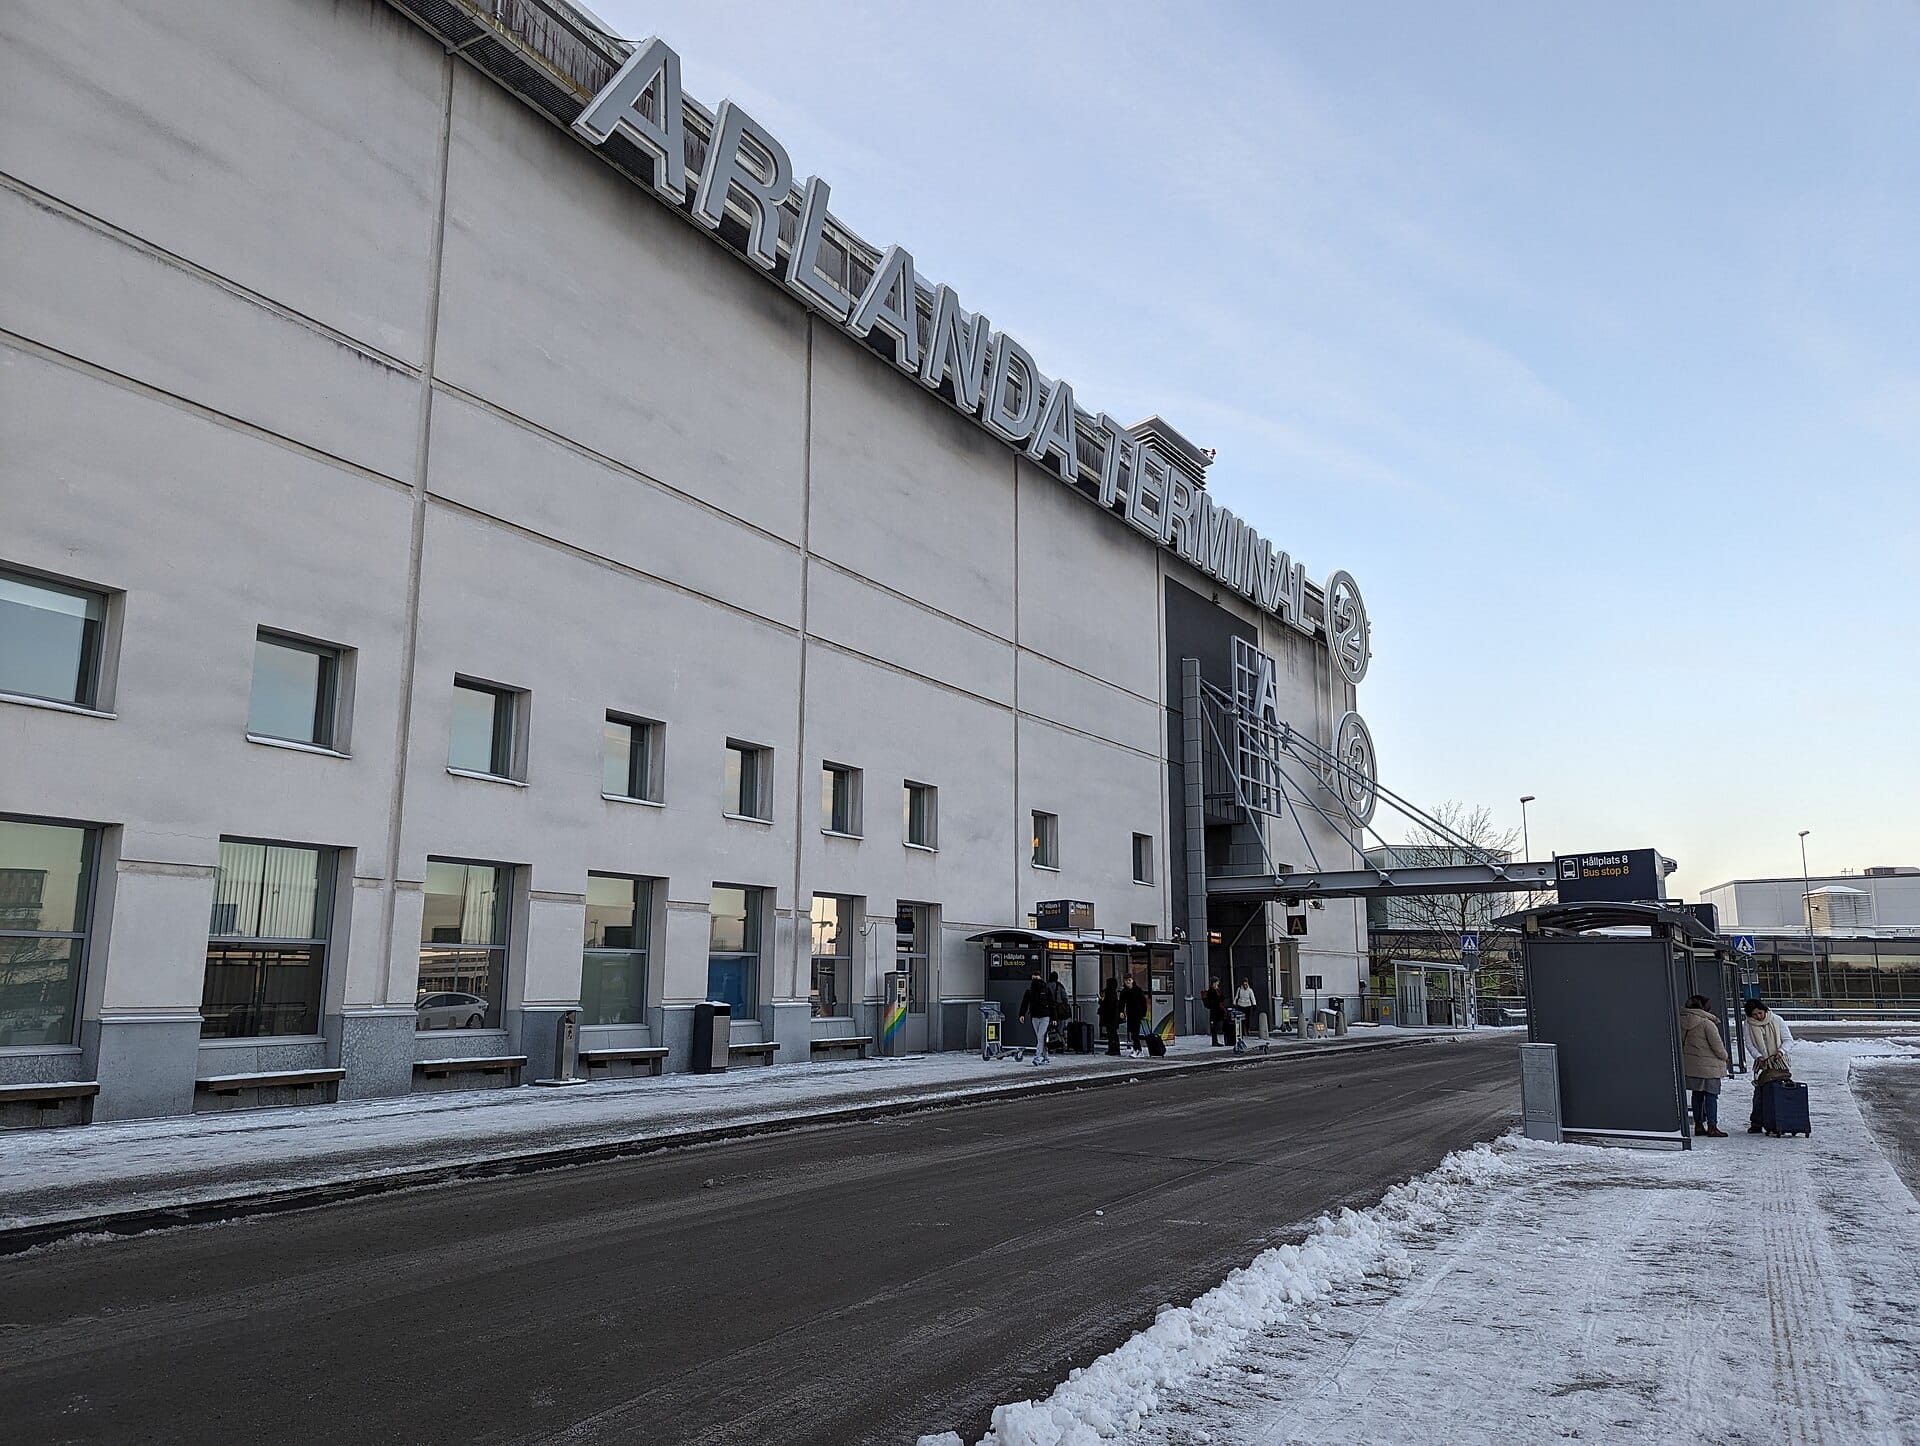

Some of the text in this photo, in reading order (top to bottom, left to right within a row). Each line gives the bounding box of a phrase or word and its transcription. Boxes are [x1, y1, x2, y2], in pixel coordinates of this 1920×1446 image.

[571, 35, 1079, 483] ARLANDA
[1096, 411, 1316, 636] TERMINAL
[1254, 655, 1280, 726] A
[1582, 854, 1629, 868] Hållplats 8
[1583, 865, 1630, 878] Bus stop 8
[1291, 917, 1304, 933] A
